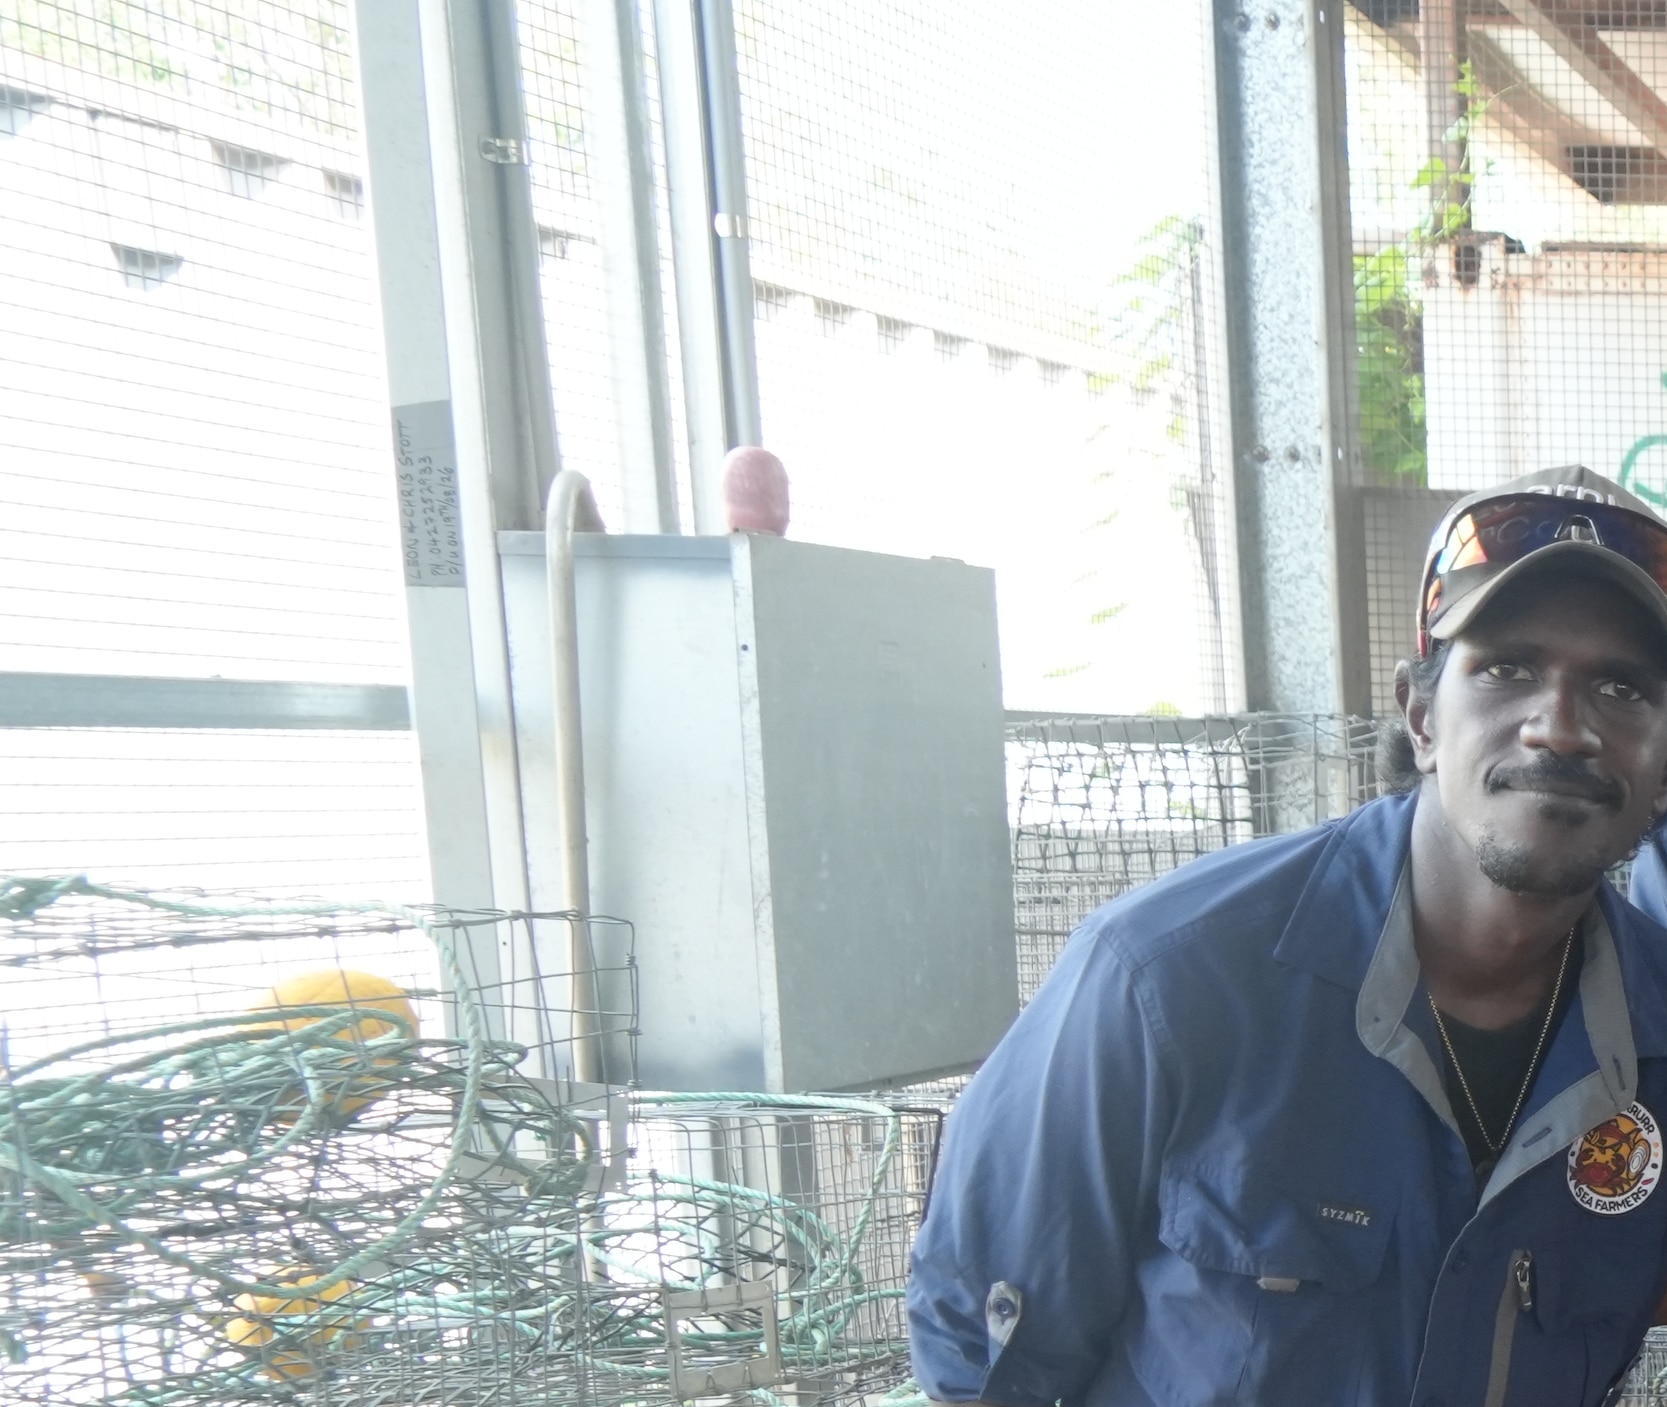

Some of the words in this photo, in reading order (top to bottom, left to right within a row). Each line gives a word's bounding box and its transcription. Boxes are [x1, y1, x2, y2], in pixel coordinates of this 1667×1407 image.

[396, 419, 414, 466] STOTT
[399, 473, 416, 517] CHRIS
[406, 538, 422, 579] LEON
[1322, 1207, 1370, 1226] SYZMIK
[1574, 1184, 1593, 1208] SEA
[1594, 1187, 1648, 1212] FARMERS
